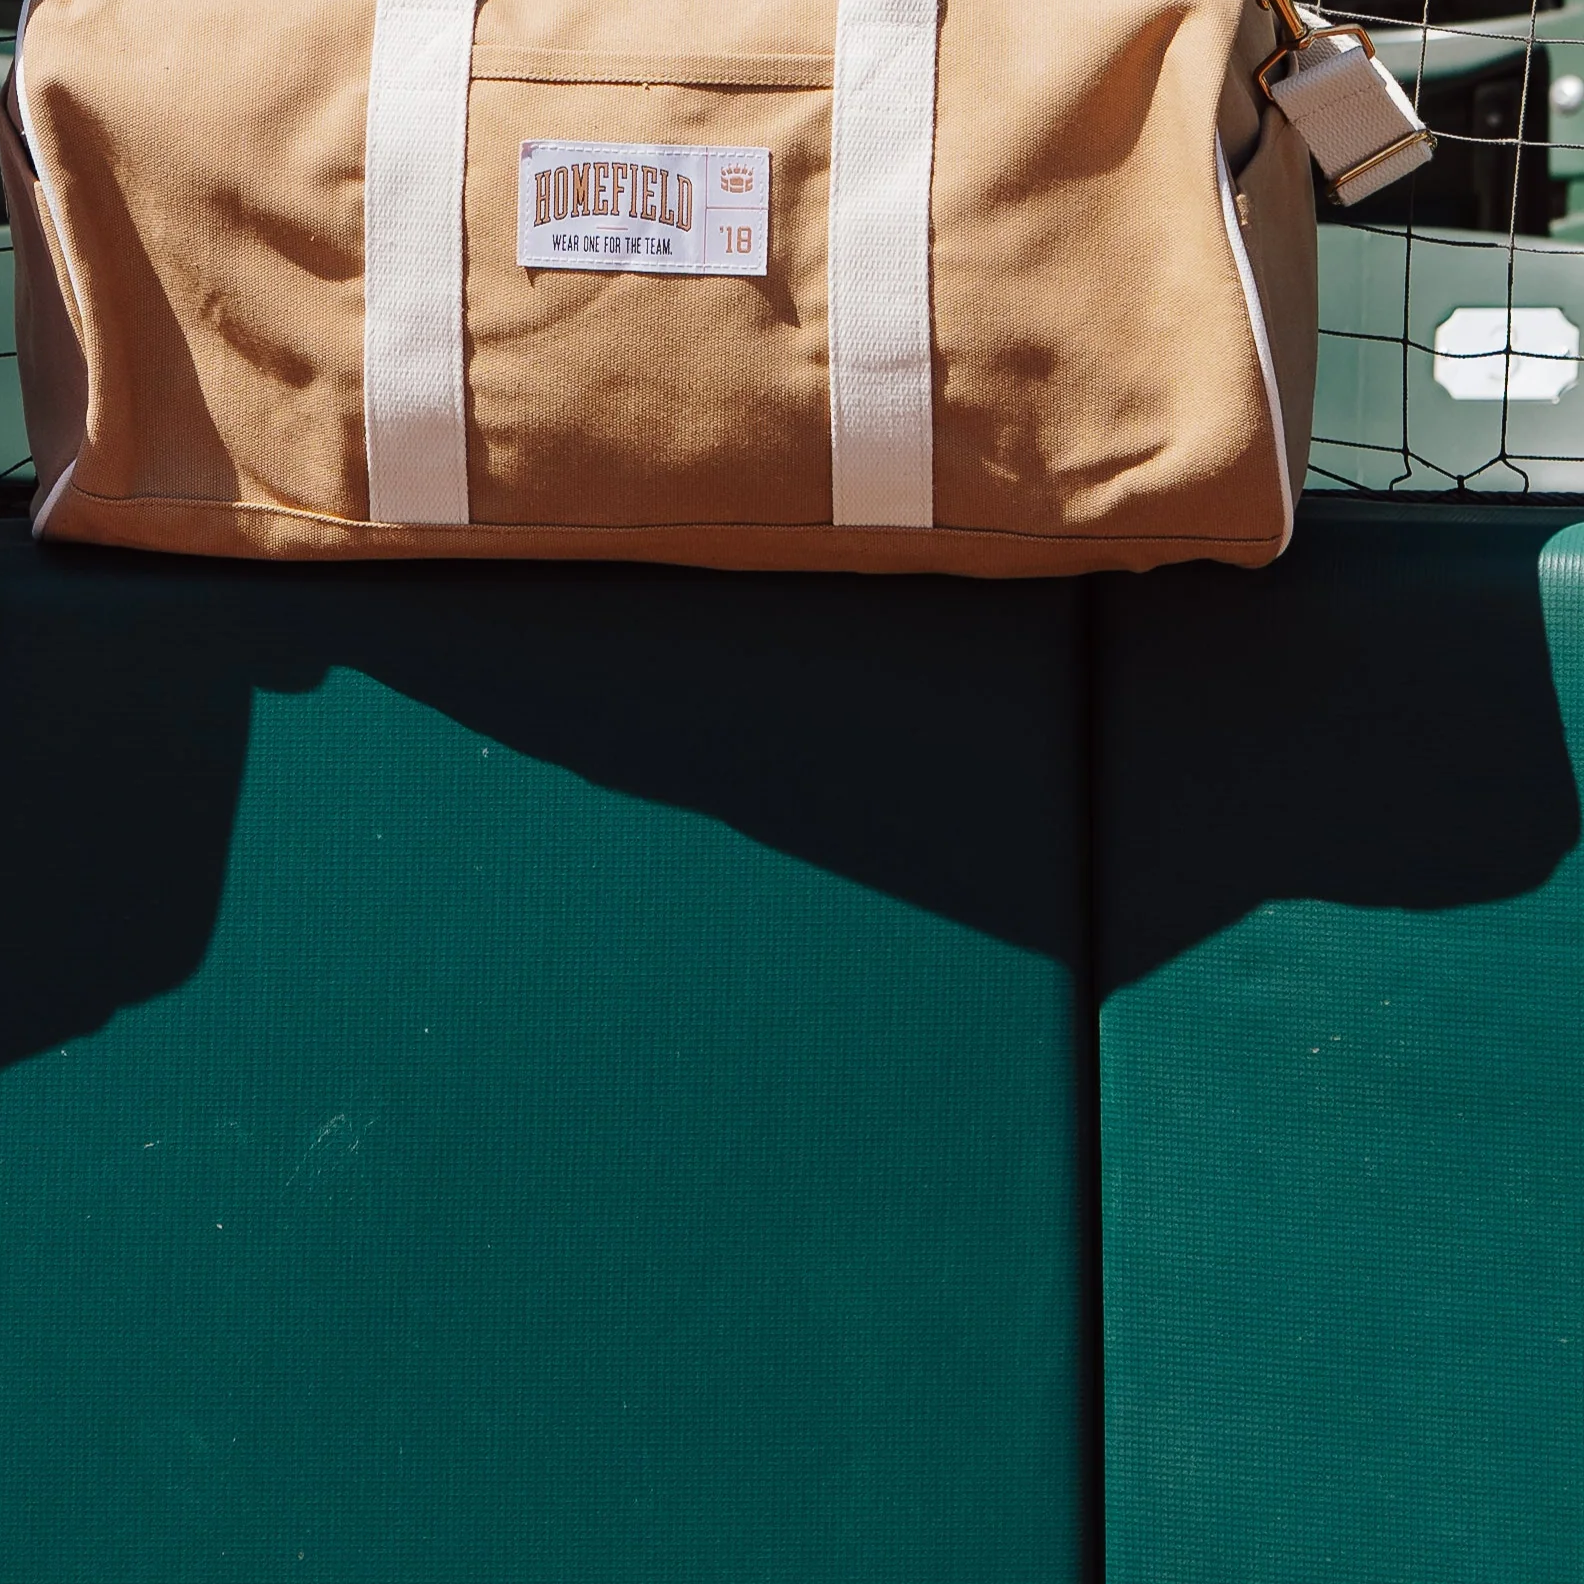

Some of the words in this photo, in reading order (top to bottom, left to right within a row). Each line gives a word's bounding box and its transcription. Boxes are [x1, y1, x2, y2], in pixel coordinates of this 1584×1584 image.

[533, 161, 693, 233] HOMEFIELD
[552, 234, 579, 253] WEAR
[583, 235, 600, 253] ONE
[603, 236, 621, 254] FOR
[625, 237, 642, 254] THE
[645, 238, 673, 256] TEAM.
